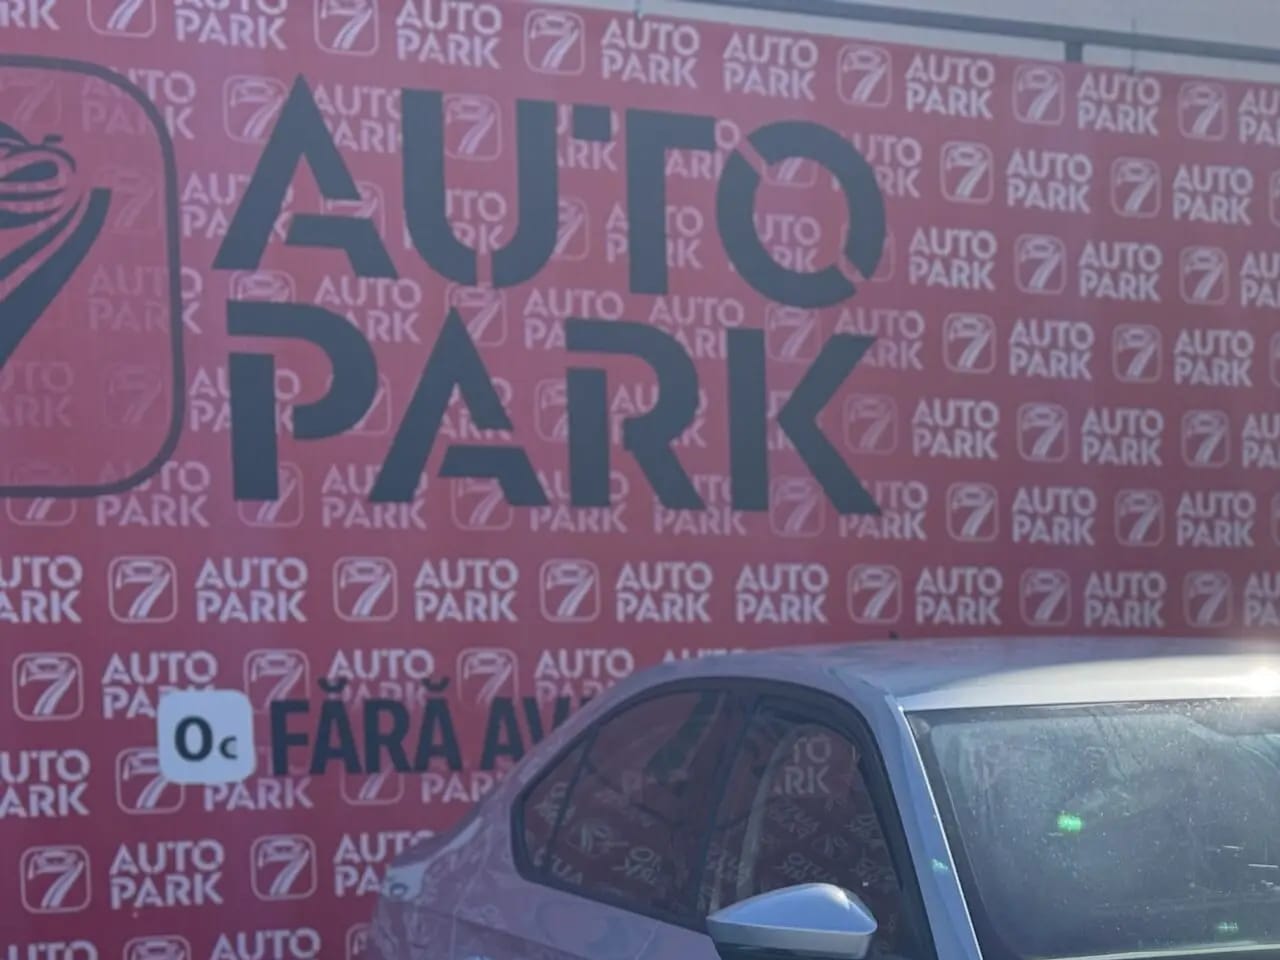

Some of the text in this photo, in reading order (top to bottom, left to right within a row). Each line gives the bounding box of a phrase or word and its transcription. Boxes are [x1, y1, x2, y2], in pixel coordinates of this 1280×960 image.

[0, 3, 59, 30] RK
[174, 9, 287, 50] PARK
[396, 0, 502, 35] AUTO
[397, 28, 499, 68] PARK
[601, 16, 699, 56] AUTO
[724, 32, 819, 69] AUTO
[602, 48, 696, 87] PARK
[724, 61, 814, 100] PARK
[905, 53, 995, 88] AUTO
[906, 81, 992, 118] PARK
[1077, 70, 1161, 104] AUTO
[1078, 99, 1158, 135] PARK
[1006, 149, 1093, 183] AUTO
[1173, 165, 1253, 195] AUTO
[213, 73, 886, 310] AUTO
[1007, 178, 1090, 213] PARK
[1173, 192, 1251, 224] PARK
[910, 228, 997, 260] AUTO
[1079, 241, 1162, 272] AUTO
[909, 255, 994, 290] PARK
[1080, 268, 1159, 301] PARK
[314, 275, 422, 310] AUTO
[523, 288, 625, 323] AUTO
[649, 295, 746, 328] AUTO
[834, 308, 926, 341] AUTO
[1009, 319, 1094, 351] AUTO
[1174, 330, 1254, 357] AUTO
[1009, 346, 1091, 380] PARK
[1174, 356, 1251, 387] PARK
[227, 301, 882, 515] PARK
[912, 399, 999, 430] AUTO
[1081, 408, 1164, 438] AUTO
[914, 428, 997, 459] PARK
[1082, 434, 1161, 466] PARK
[96, 496, 210, 527] PARK
[321, 497, 427, 530] PARK
[1012, 487, 1096, 516] AUTO
[1176, 491, 1256, 519] AUTO
[1012, 515, 1094, 545] PARK
[1177, 518, 1253, 547] PARK
[196, 558, 307, 589] AUTO
[415, 559, 518, 589] AUTO
[616, 562, 712, 591] AUTO
[736, 564, 829, 593] AUTO
[915, 567, 1003, 596] AUTO
[1084, 571, 1166, 600] AUTO
[197, 590, 305, 622] PARK
[416, 590, 516, 622] PARK
[616, 591, 710, 622] PARK
[736, 592, 826, 623] PARK
[916, 595, 1000, 625] PARK
[1084, 599, 1164, 627] PARK
[102, 651, 218, 685] AUTO
[327, 648, 436, 681] AUTO
[534, 648, 635, 679] AUTO
[270, 677, 463, 776] FĂRĂ
[203, 778, 314, 811] PARK
[110, 840, 224, 875] AUTO
[111, 872, 222, 909] PARK
